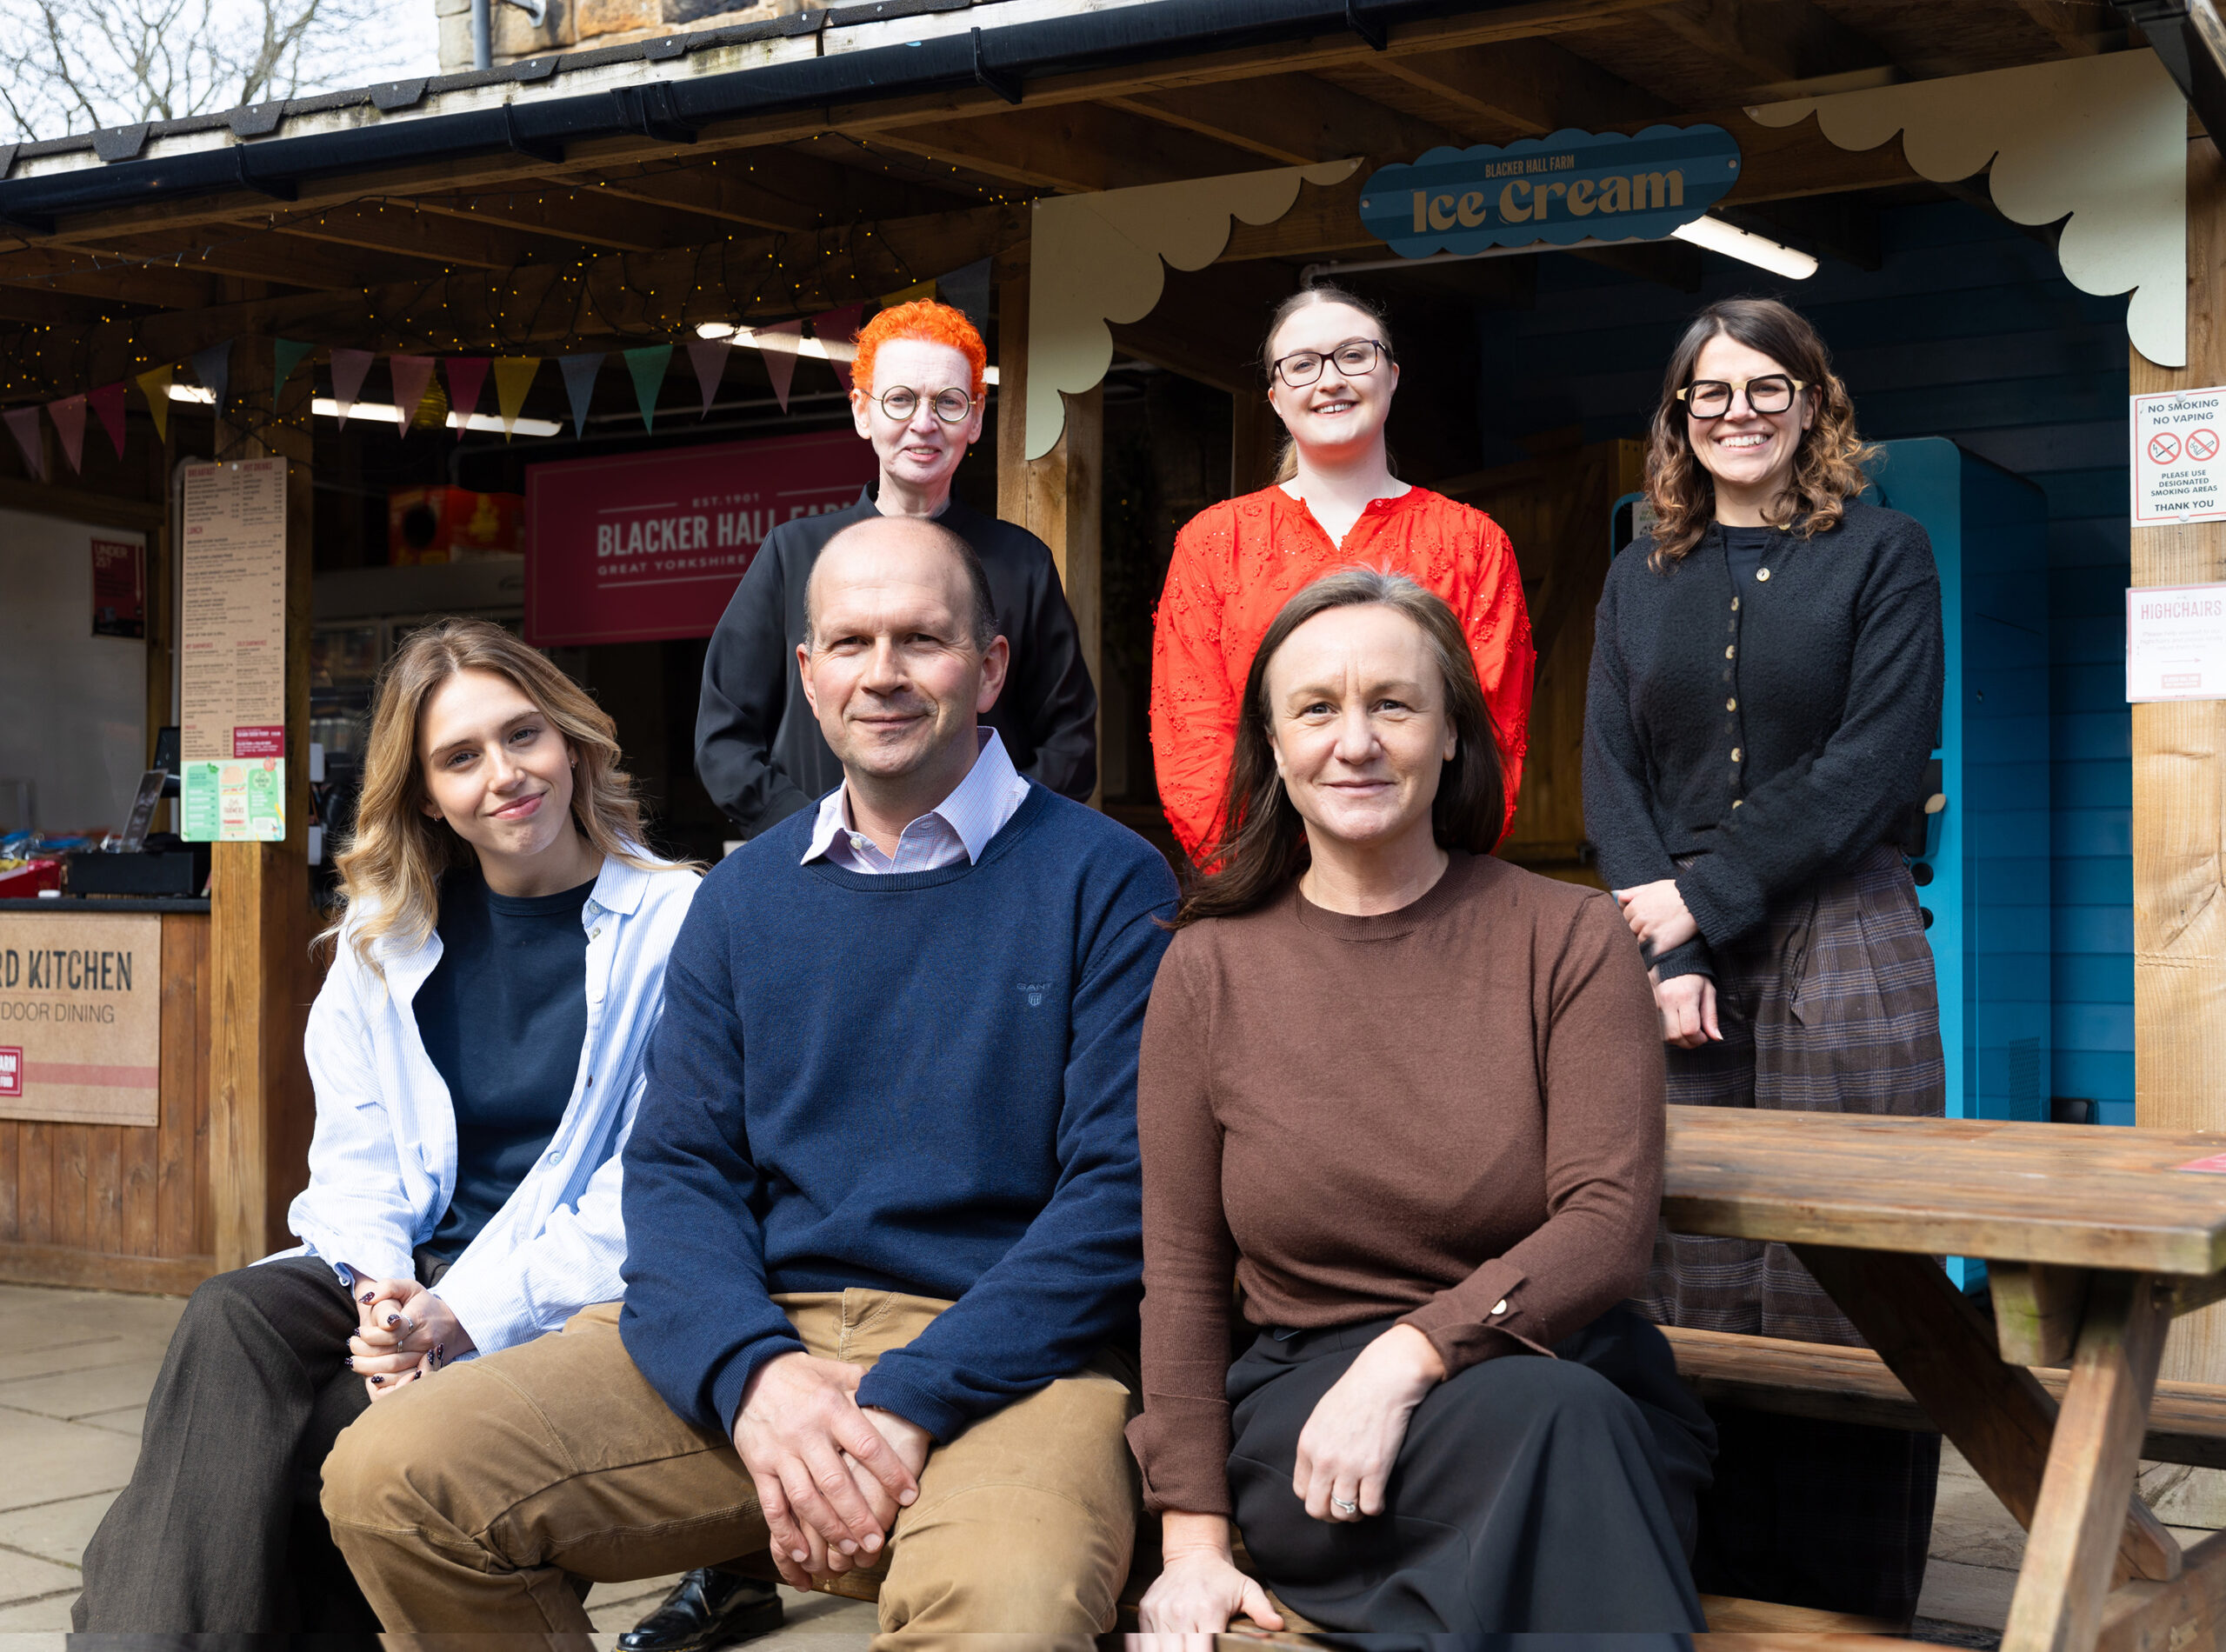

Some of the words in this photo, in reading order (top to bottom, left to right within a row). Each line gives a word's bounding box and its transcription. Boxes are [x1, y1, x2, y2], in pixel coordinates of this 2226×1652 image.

[1485, 160, 1524, 178] BLACKER
[1526, 157, 1548, 174] HALL
[1550, 155, 1575, 171] FARM
[1411, 190, 1486, 232] Ice
[1499, 169, 1684, 223] Cream
[2148, 404, 2164, 413] NO
[2168, 399, 2219, 411] SMOKING
[2153, 416, 2169, 425] NO
[2173, 412, 2214, 423] VAPING
[2158, 477, 2209, 488] DESIGNATED
[2162, 470, 2189, 479] PLEASE
[2151, 487, 2190, 496] SMOKING
[2155, 502, 2189, 511] THANK
[2192, 500, 2214, 509] YOU
[596, 516, 709, 557] BLACKER
[597, 562, 648, 576] GREAT
[655, 554, 746, 571] YORKSHIRE
[2141, 600, 2222, 619] HIGHCHAIRS
[0, 949, 19, 989] D
[29, 950, 132, 991] KITCHEN
[1, 1002, 50, 1022] DOOR
[55, 1003, 115, 1024] DINING
